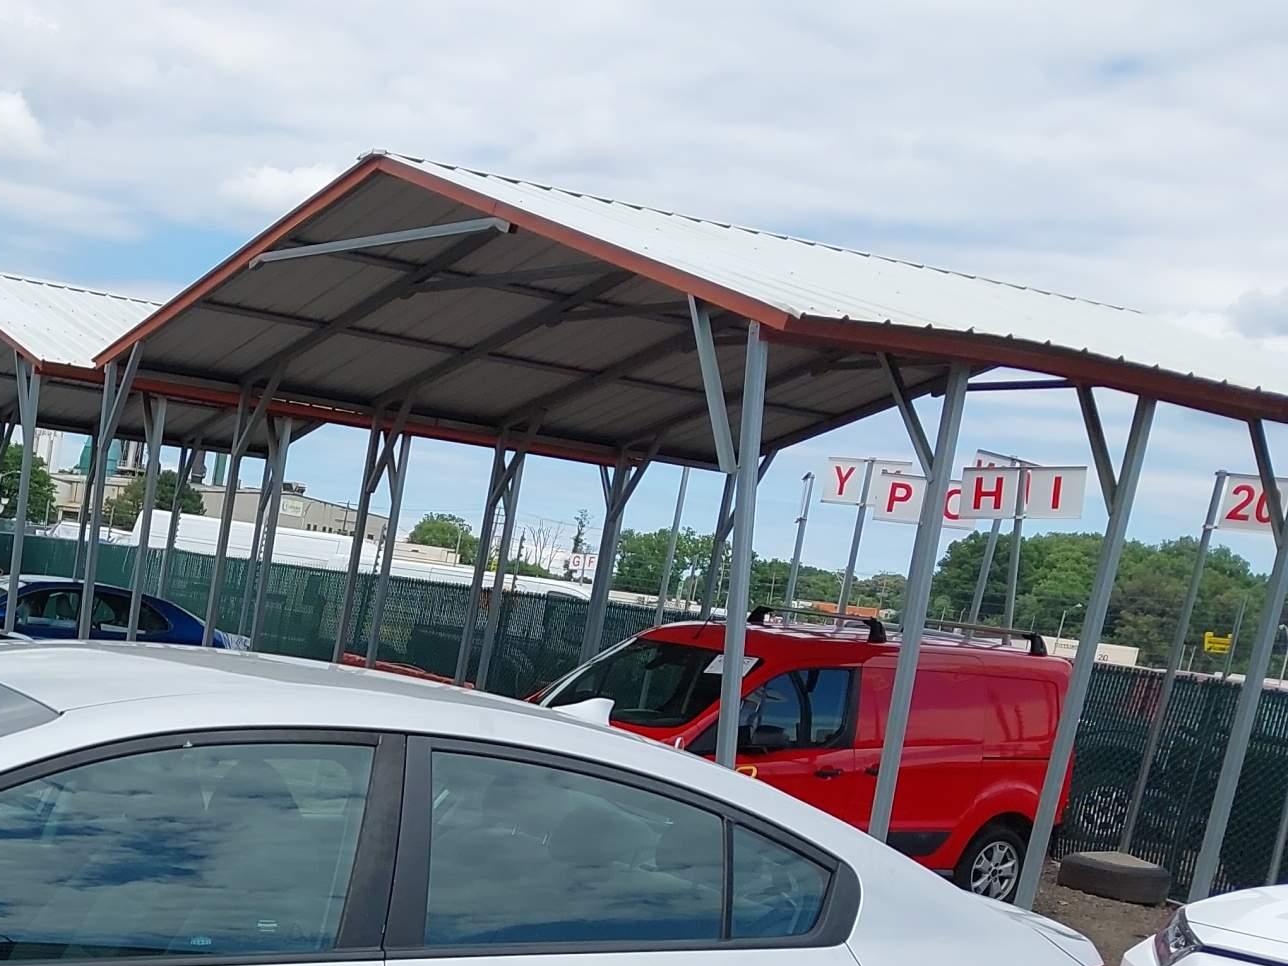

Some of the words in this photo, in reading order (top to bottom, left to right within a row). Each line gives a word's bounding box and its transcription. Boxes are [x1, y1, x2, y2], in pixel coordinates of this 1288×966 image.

[835, 465, 856, 496] Y
[973, 476, 1004, 510] H
[1050, 476, 1063, 510] I
[886, 481, 913, 513] P
[572, 555, 581, 567] G
[588, 556, 596, 567] F
